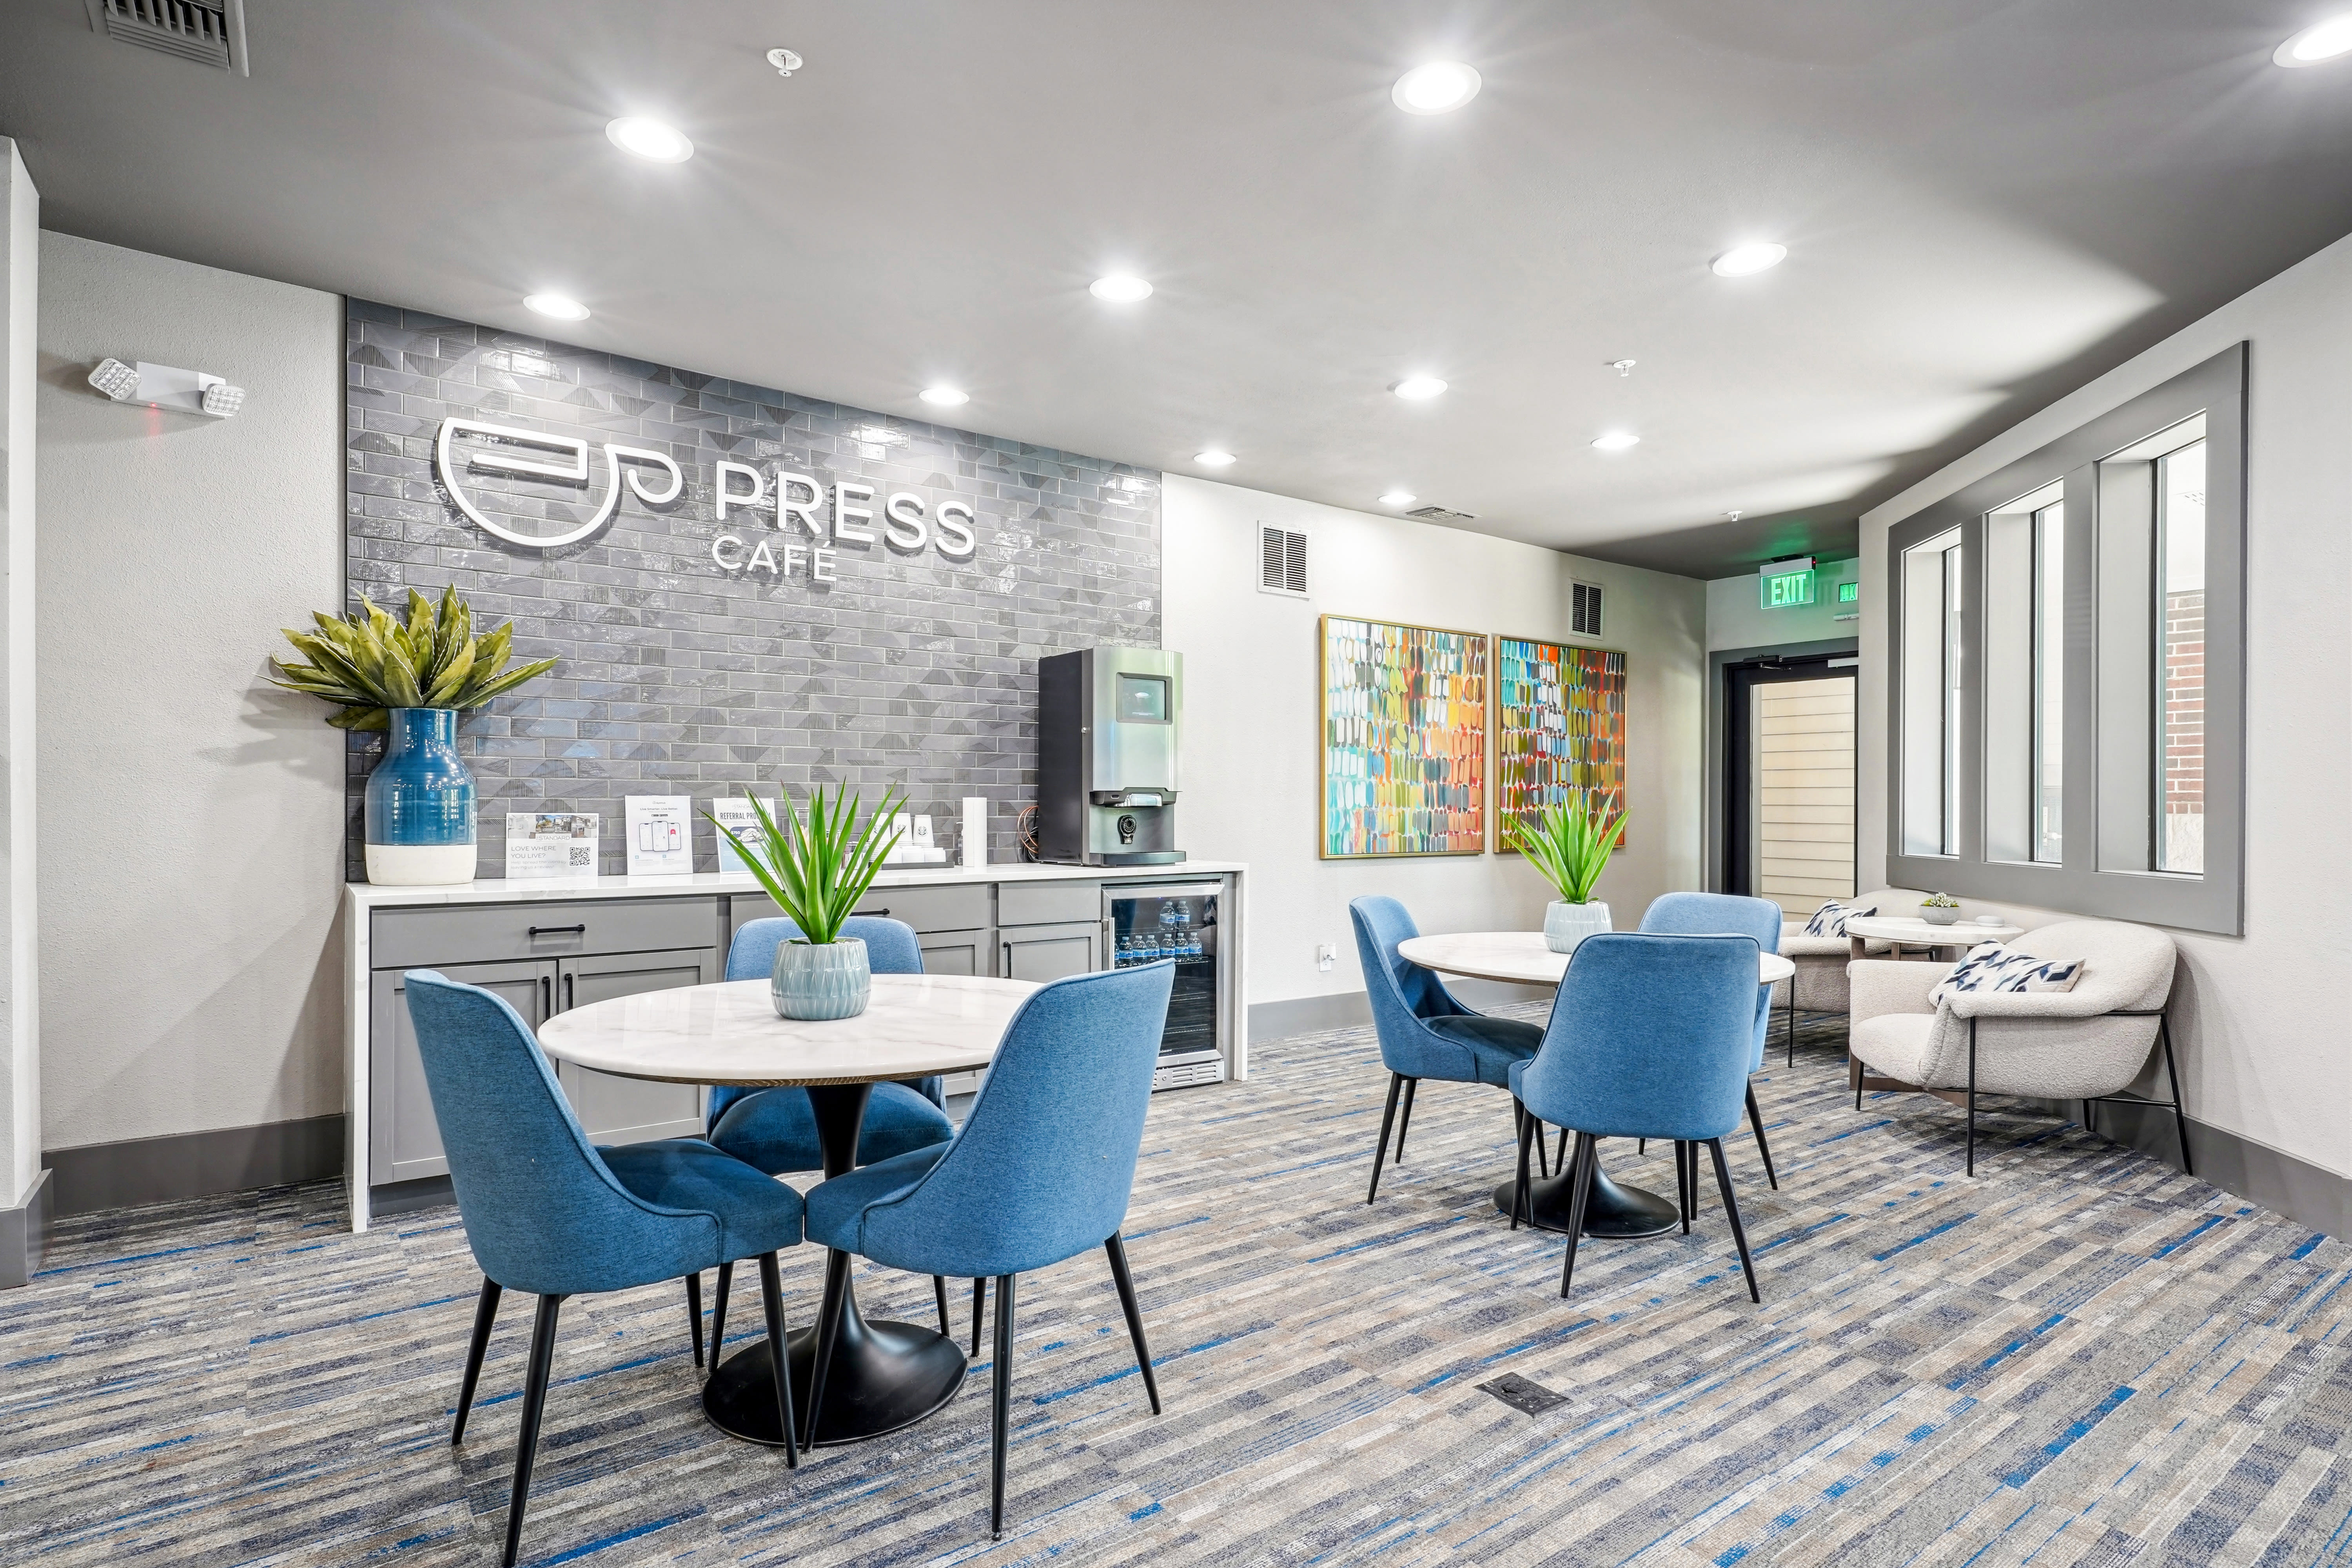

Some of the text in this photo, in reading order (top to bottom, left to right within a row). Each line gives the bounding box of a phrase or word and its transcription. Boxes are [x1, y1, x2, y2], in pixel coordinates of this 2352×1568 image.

[716, 460, 975, 555] PRESS
[711, 535, 837, 581] CAFÉ
[1771, 574, 1806, 605] EXIT
